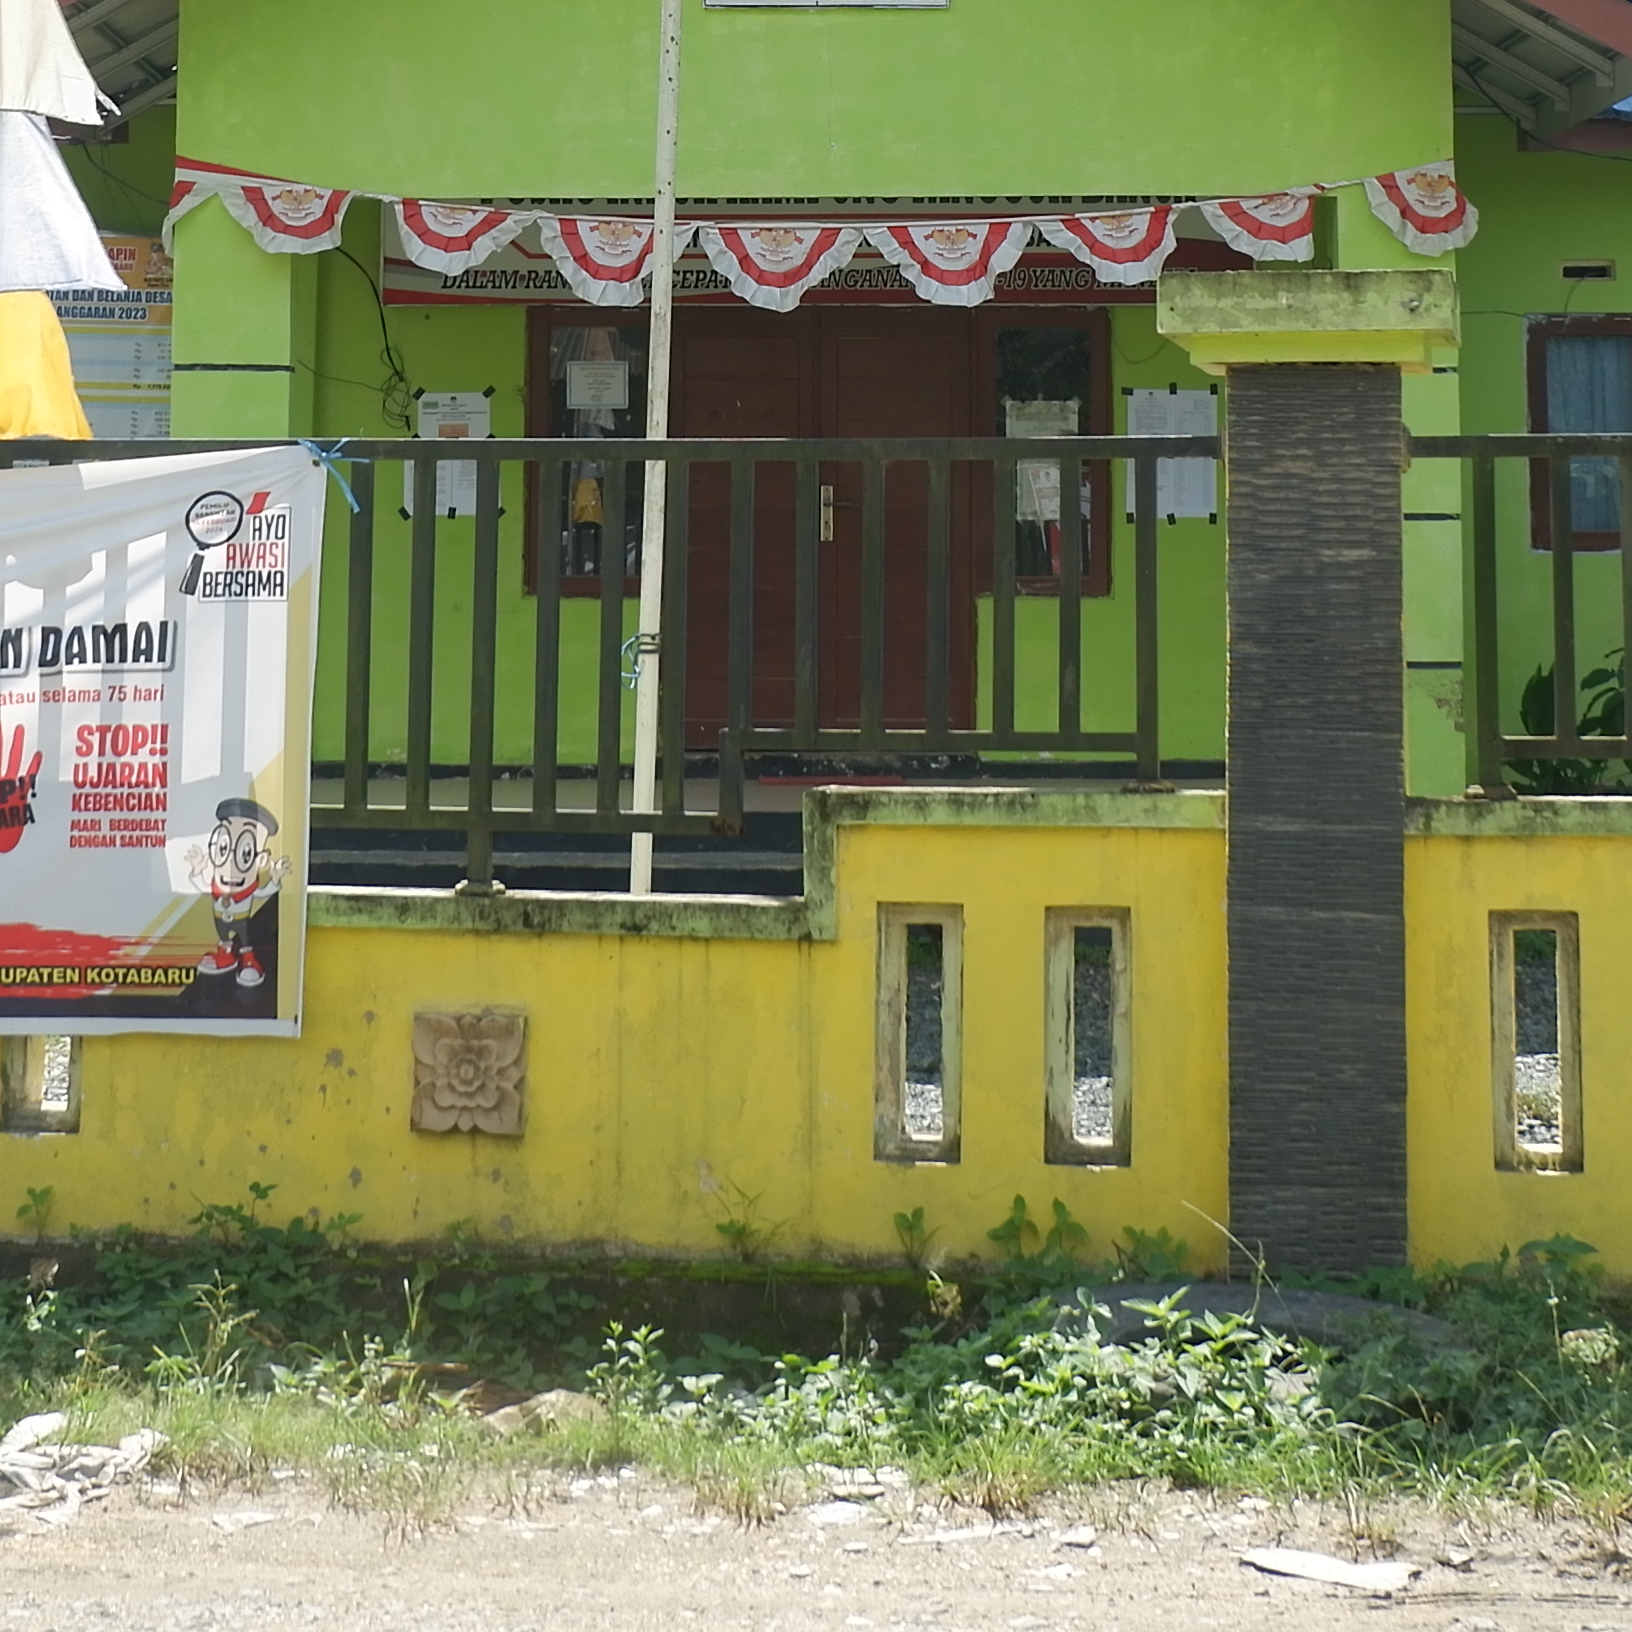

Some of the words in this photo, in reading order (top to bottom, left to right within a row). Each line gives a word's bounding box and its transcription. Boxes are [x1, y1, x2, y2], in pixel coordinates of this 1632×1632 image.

[441, 269, 519, 289] DALAM
[1030, 268, 1093, 289] YANG
[72, 289, 95, 302] DAN
[97, 290, 142, 303] BELANJA
[57, 305, 116, 319] ANGGARAN
[118, 306, 146, 320] 2023
[252, 513, 287, 541] AYO
[226, 542, 285, 570] AWASI
[201, 570, 285, 598] BERSAMA
[38, 620, 169, 668] DAMAI
[42, 686, 101, 703] selama
[108, 685, 126, 702] 75
[134, 684, 165, 702] hari
[75, 723, 169, 757] STOP!!
[72, 761, 168, 789] UJARAN
[71, 791, 167, 812] KEBENCIAN
[70, 818, 102, 832] MARI
[109, 818, 167, 832] BERDEBAT
[69, 834, 116, 848] DENGAN
[119, 834, 167, 848] SANTUN
[85, 966, 196, 985] KOTABARU
